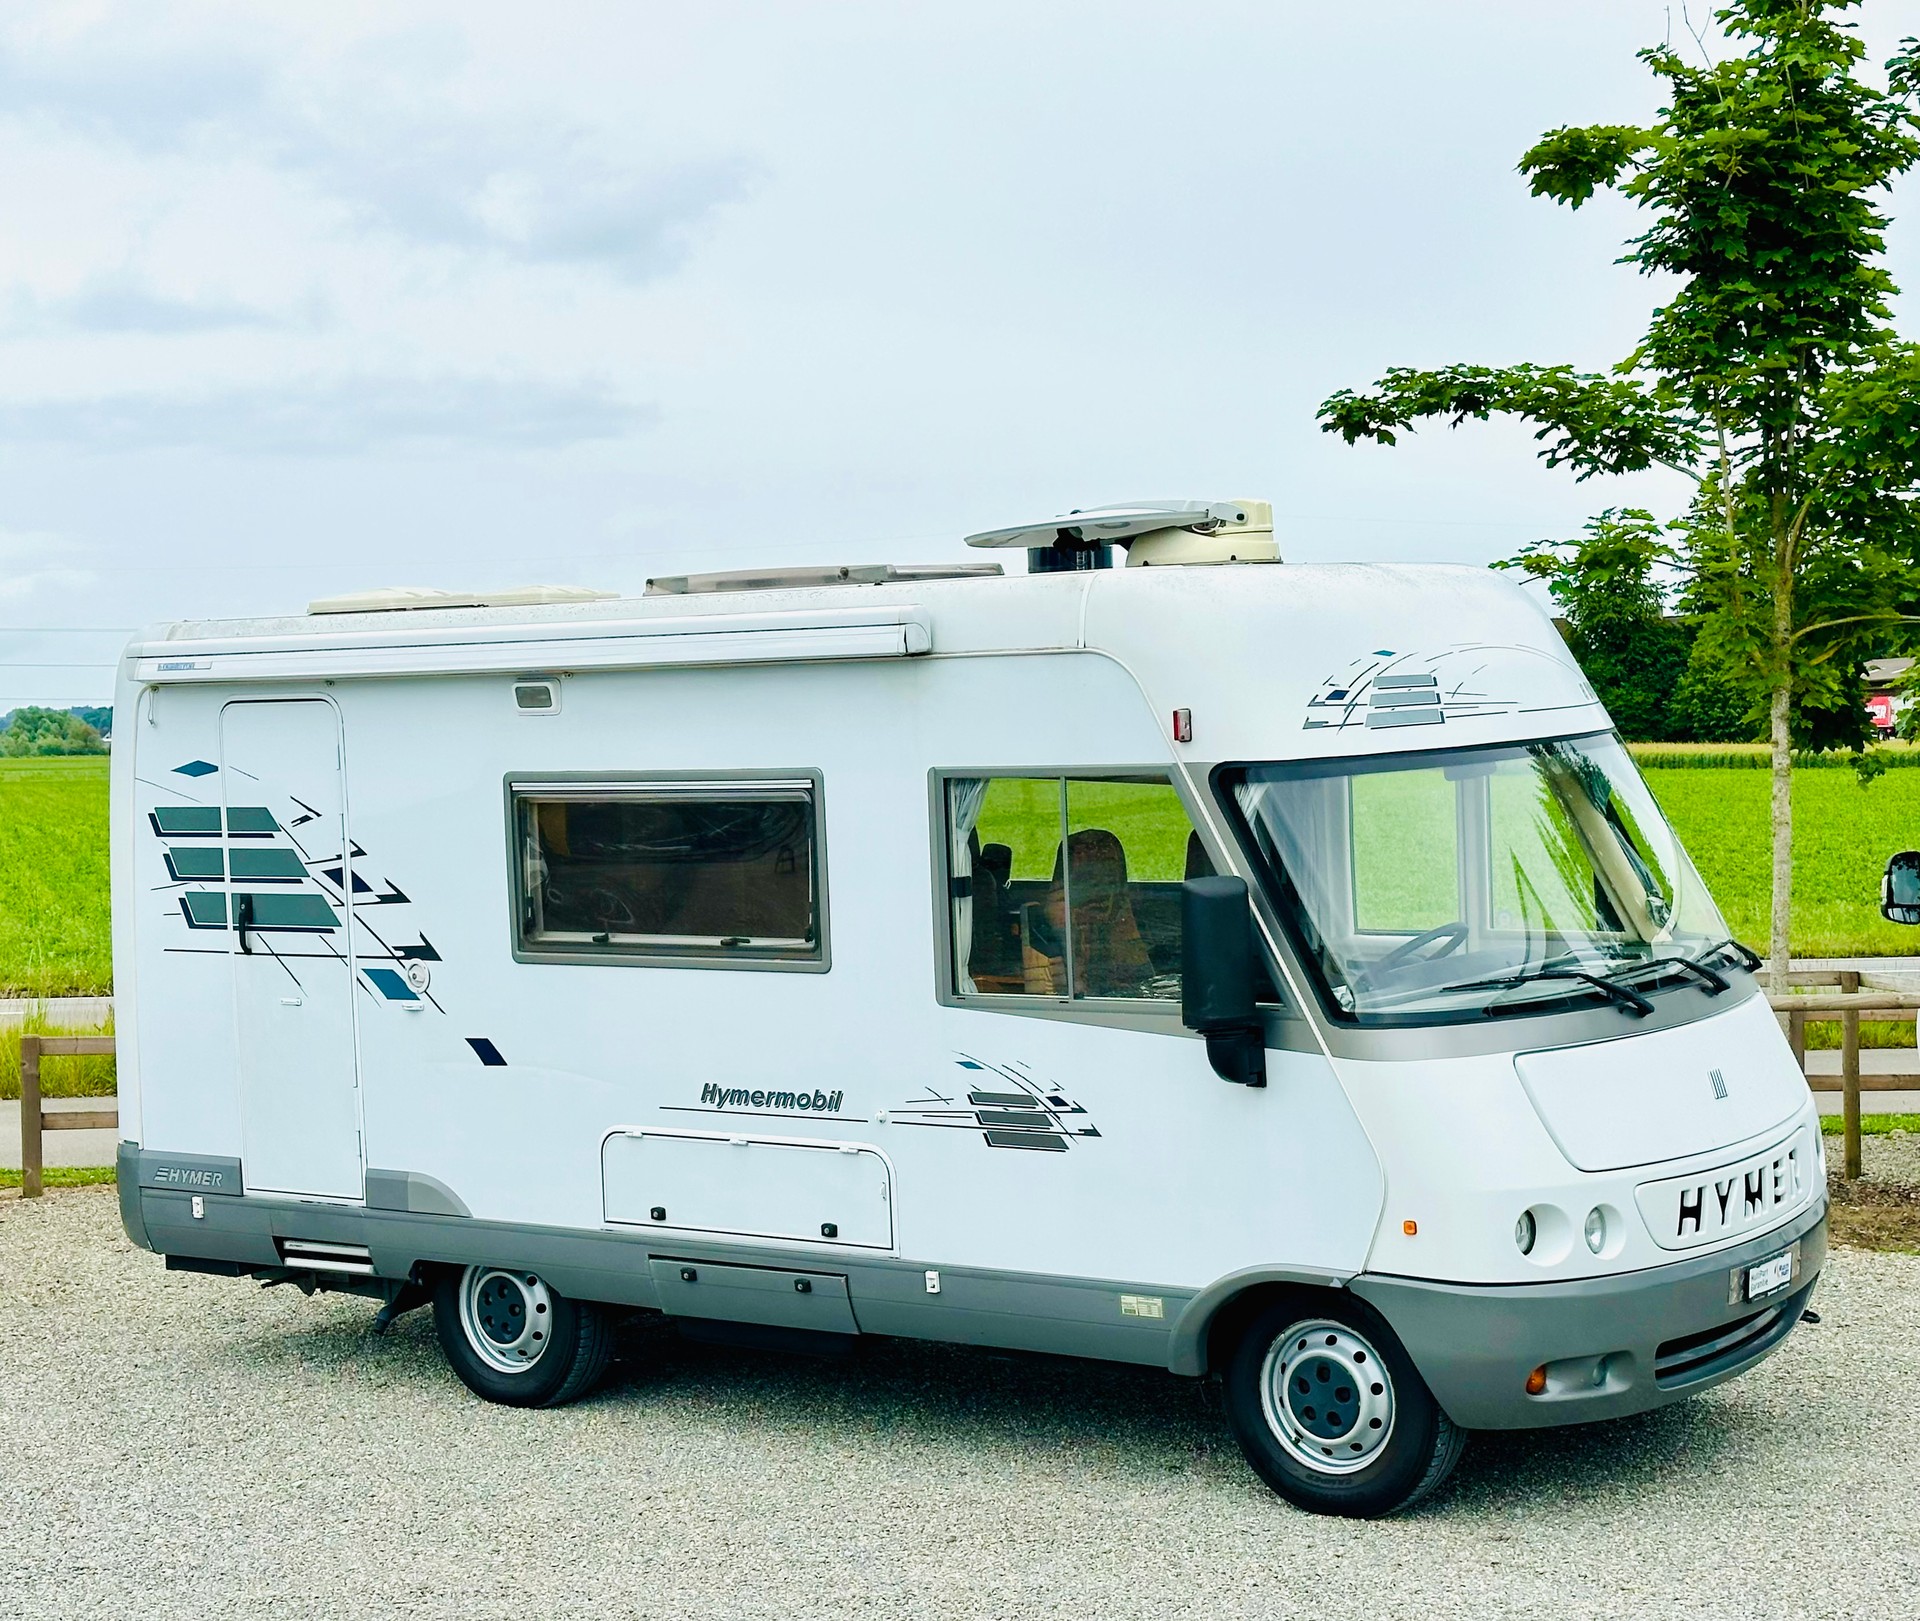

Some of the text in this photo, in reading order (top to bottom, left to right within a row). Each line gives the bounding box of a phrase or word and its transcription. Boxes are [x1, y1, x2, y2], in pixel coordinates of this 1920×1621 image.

[700, 1082, 844, 1112] Hymermobil
[168, 1167, 224, 1188] HYMER
[1676, 1148, 1803, 1239] HYMER
